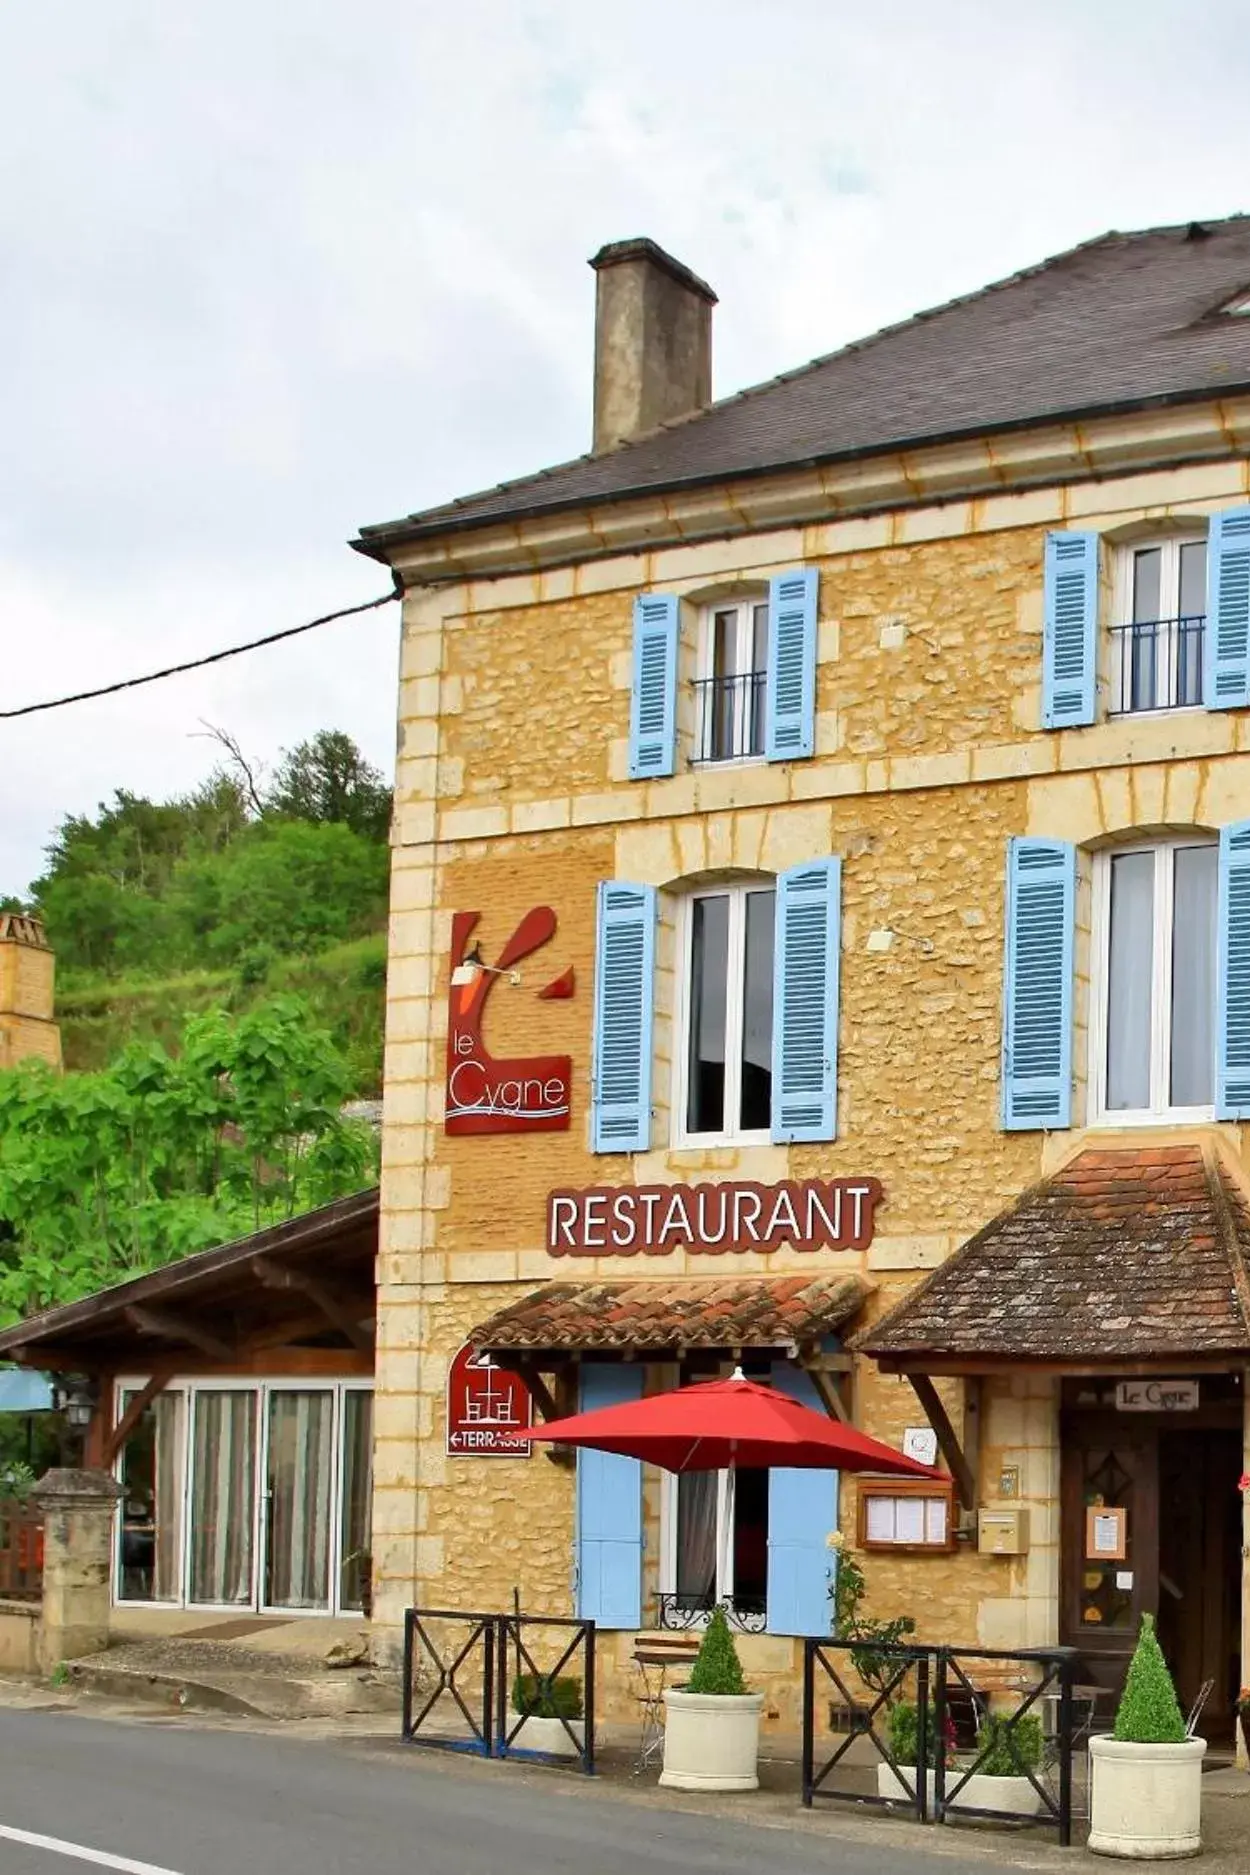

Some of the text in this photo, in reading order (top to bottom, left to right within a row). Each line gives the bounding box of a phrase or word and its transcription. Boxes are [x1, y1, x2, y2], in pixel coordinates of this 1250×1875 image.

[454, 1030, 474, 1055] le
[449, 1060, 565, 1115] Cygne
[550, 1187, 870, 1247] RESTAURANT
[1122, 1385, 1141, 1404] Le
